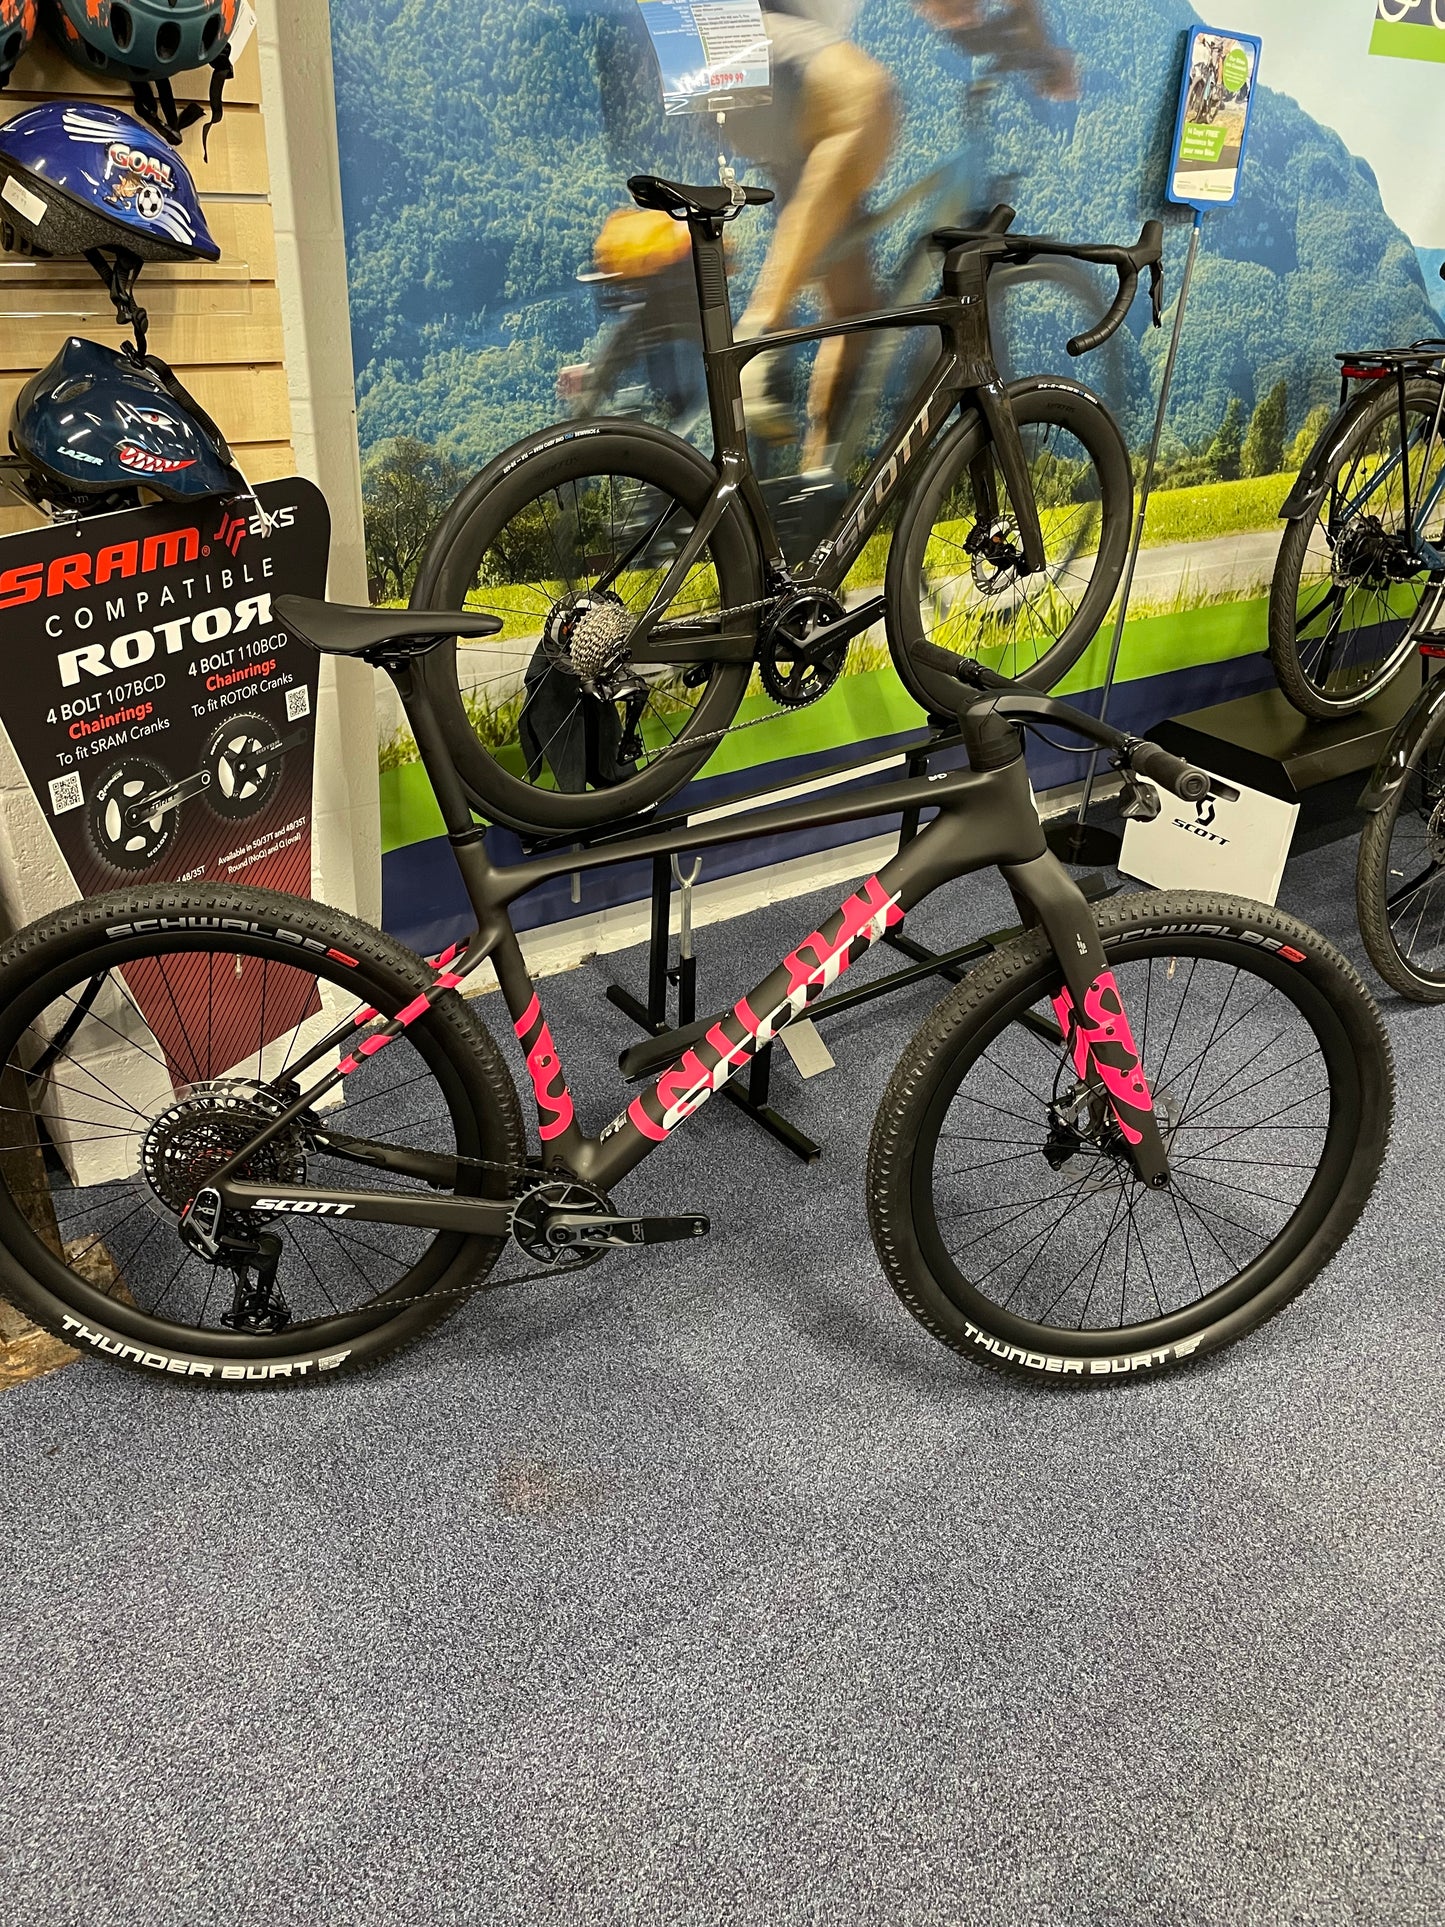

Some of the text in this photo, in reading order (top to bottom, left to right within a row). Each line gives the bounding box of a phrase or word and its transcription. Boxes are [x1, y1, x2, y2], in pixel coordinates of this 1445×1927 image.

[57, 446, 104, 466] LAZER
[0, 527, 200, 610] SRAM
[45, 557, 274, 638] COMPATIBLE
[57, 592, 274, 687] ROTOR
[188, 633, 288, 677] 4 BOLT 110BCD
[191, 673, 294, 717] To fit ROTOR Cranks
[206, 659, 277, 691] Chainrings
[46, 673, 166, 724] 4 BOLT 107BCD
[69, 701, 153, 740] Chainrings
[56, 717, 170, 767] To fit SRAM Cranks
[1171, 818, 1231, 846] SCOTT
[105, 916, 327, 953] SCHWALBE
[250, 1198, 356, 1216] SCOTT
[61, 1314, 214, 1377] THUNDER
[221, 1360, 313, 1380] BURT
[962, 1321, 1170, 1375] THUNDER BURT
